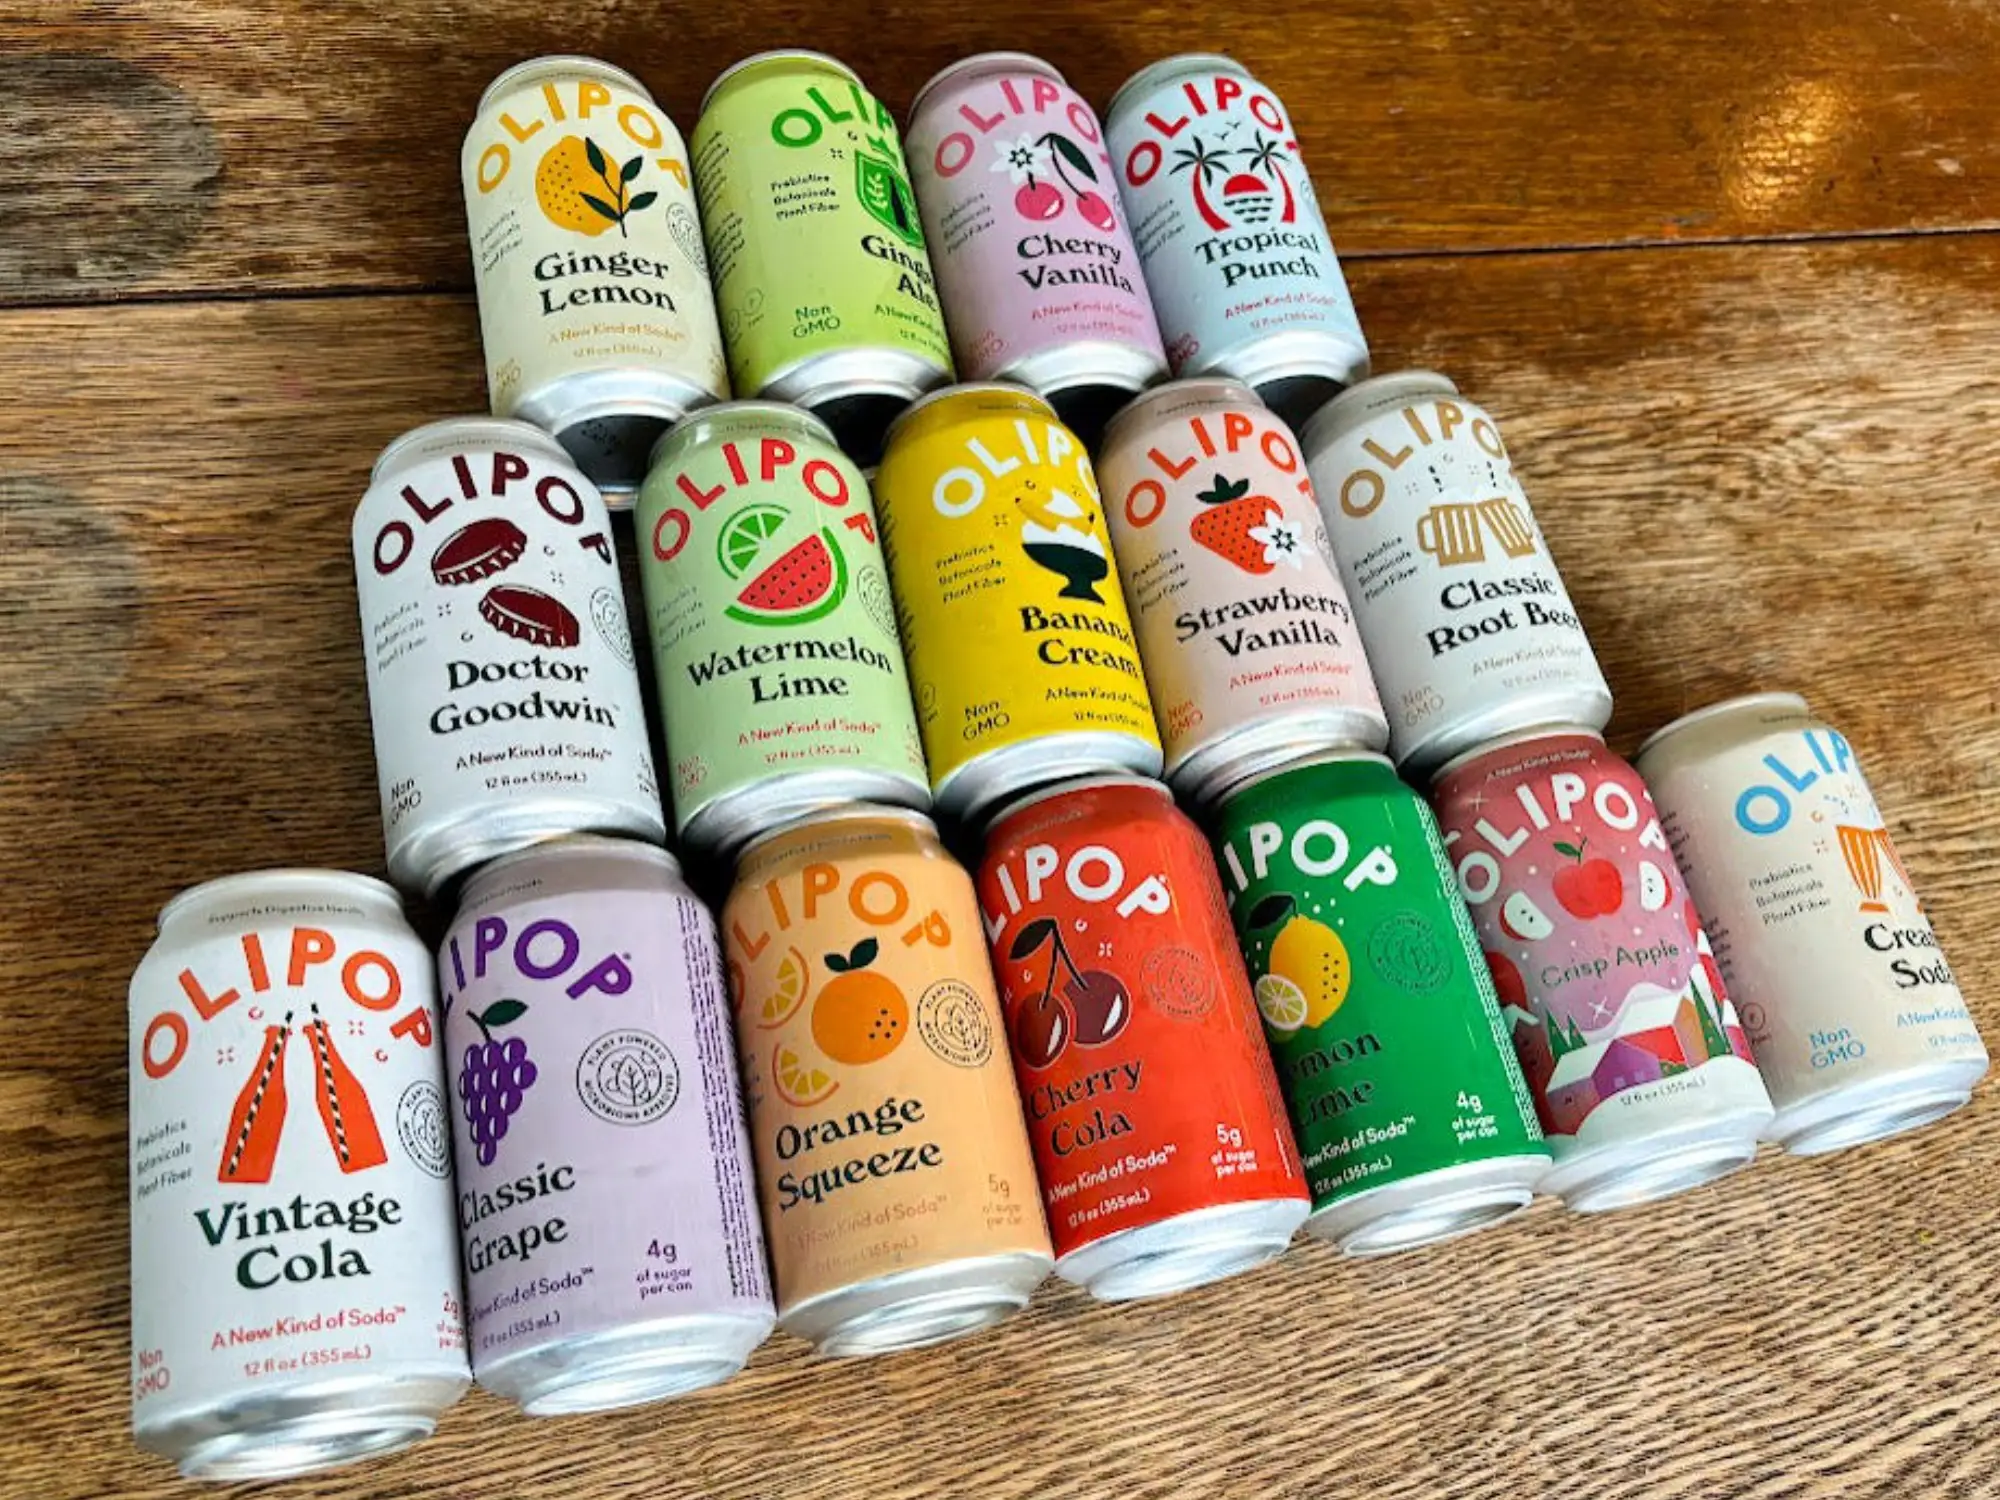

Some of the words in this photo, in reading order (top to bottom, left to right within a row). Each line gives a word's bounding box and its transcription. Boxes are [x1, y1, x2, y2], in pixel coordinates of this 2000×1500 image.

[934, 79, 1111, 178] OLIPO
[1125, 77, 1298, 188] OLIPO
[1016, 233, 1121, 264] Cherry
[1194, 227, 1322, 264] Tropical
[534, 250, 669, 281] Ginger
[1017, 263, 1136, 295] Vanilla
[1220, 256, 1321, 288] Punch
[539, 286, 677, 316] Lemon
[795, 306, 832, 323] Non
[793, 315, 841, 339] GMO
[373, 452, 613, 575] OLIPOP
[653, 437, 876, 563] OLIPOP
[1440, 571, 1559, 611] Classic
[1174, 586, 1350, 645] Strawberry
[1215, 618, 1342, 657] Vanilla
[1425, 608, 1518, 658] Root
[446, 655, 589, 692] Doctor
[686, 636, 894, 688] Watermelon
[749, 672, 850, 705] Lime
[962, 713, 1010, 740] GMO
[964, 700, 1001, 721] Non
[456, 756, 468, 771] A
[470, 751, 507, 766] New
[508, 746, 547, 760] Kind
[548, 746, 563, 758] of
[391, 778, 415, 801] Non
[1863, 923, 1936, 951] Crea
[1541, 959, 1608, 988] Crisp
[1615, 941, 1681, 967] Apple
[142, 927, 433, 1080] OLIPOP
[1810, 1027, 1851, 1050] Non
[1810, 1040, 1866, 1069] GMO
[1028, 1058, 1143, 1122] Cherry
[1456, 1091, 1483, 1114] 4g
[775, 1097, 926, 1161] Orange
[1051, 1109, 1134, 1157] Cola
[1215, 1122, 1243, 1148] 5g
[1452, 1119, 1464, 1131] of
[1465, 1114, 1497, 1130] sugar
[1456, 1131, 1478, 1145] per
[1478, 1125, 1499, 1139] can
[1210, 1152, 1224, 1166] of
[1225, 1150, 1256, 1164] sugar
[1321, 1137, 1351, 1162] Kind
[1351, 1131, 1366, 1151] of
[777, 1141, 943, 1213] Squeeze
[988, 1173, 1010, 1199] 5g
[1077, 1167, 1108, 1192] Kind
[1108, 1160, 1124, 1179] of
[1215, 1164, 1236, 1180] per
[1237, 1161, 1258, 1174] can
[460, 1163, 576, 1232] Classic
[193, 1192, 402, 1247] Vintage
[874, 1208, 891, 1226] of
[467, 1217, 569, 1276] Grape
[647, 1239, 678, 1264] 4g
[236, 1238, 371, 1290] Cola
[636, 1269, 651, 1284] of
[652, 1267, 692, 1284] sugar
[493, 1290, 522, 1316] Kind
[521, 1280, 537, 1302] of
[639, 1285, 664, 1300] per
[666, 1280, 693, 1293] can
[211, 1332, 228, 1350] A
[229, 1326, 274, 1345] New
[276, 1313, 323, 1336] Kind
[325, 1307, 347, 1330] of
[137, 1347, 163, 1371] Non
[244, 1361, 262, 1377] 12
[278, 1358, 298, 1372] oz
[135, 1368, 171, 1400] GMO
